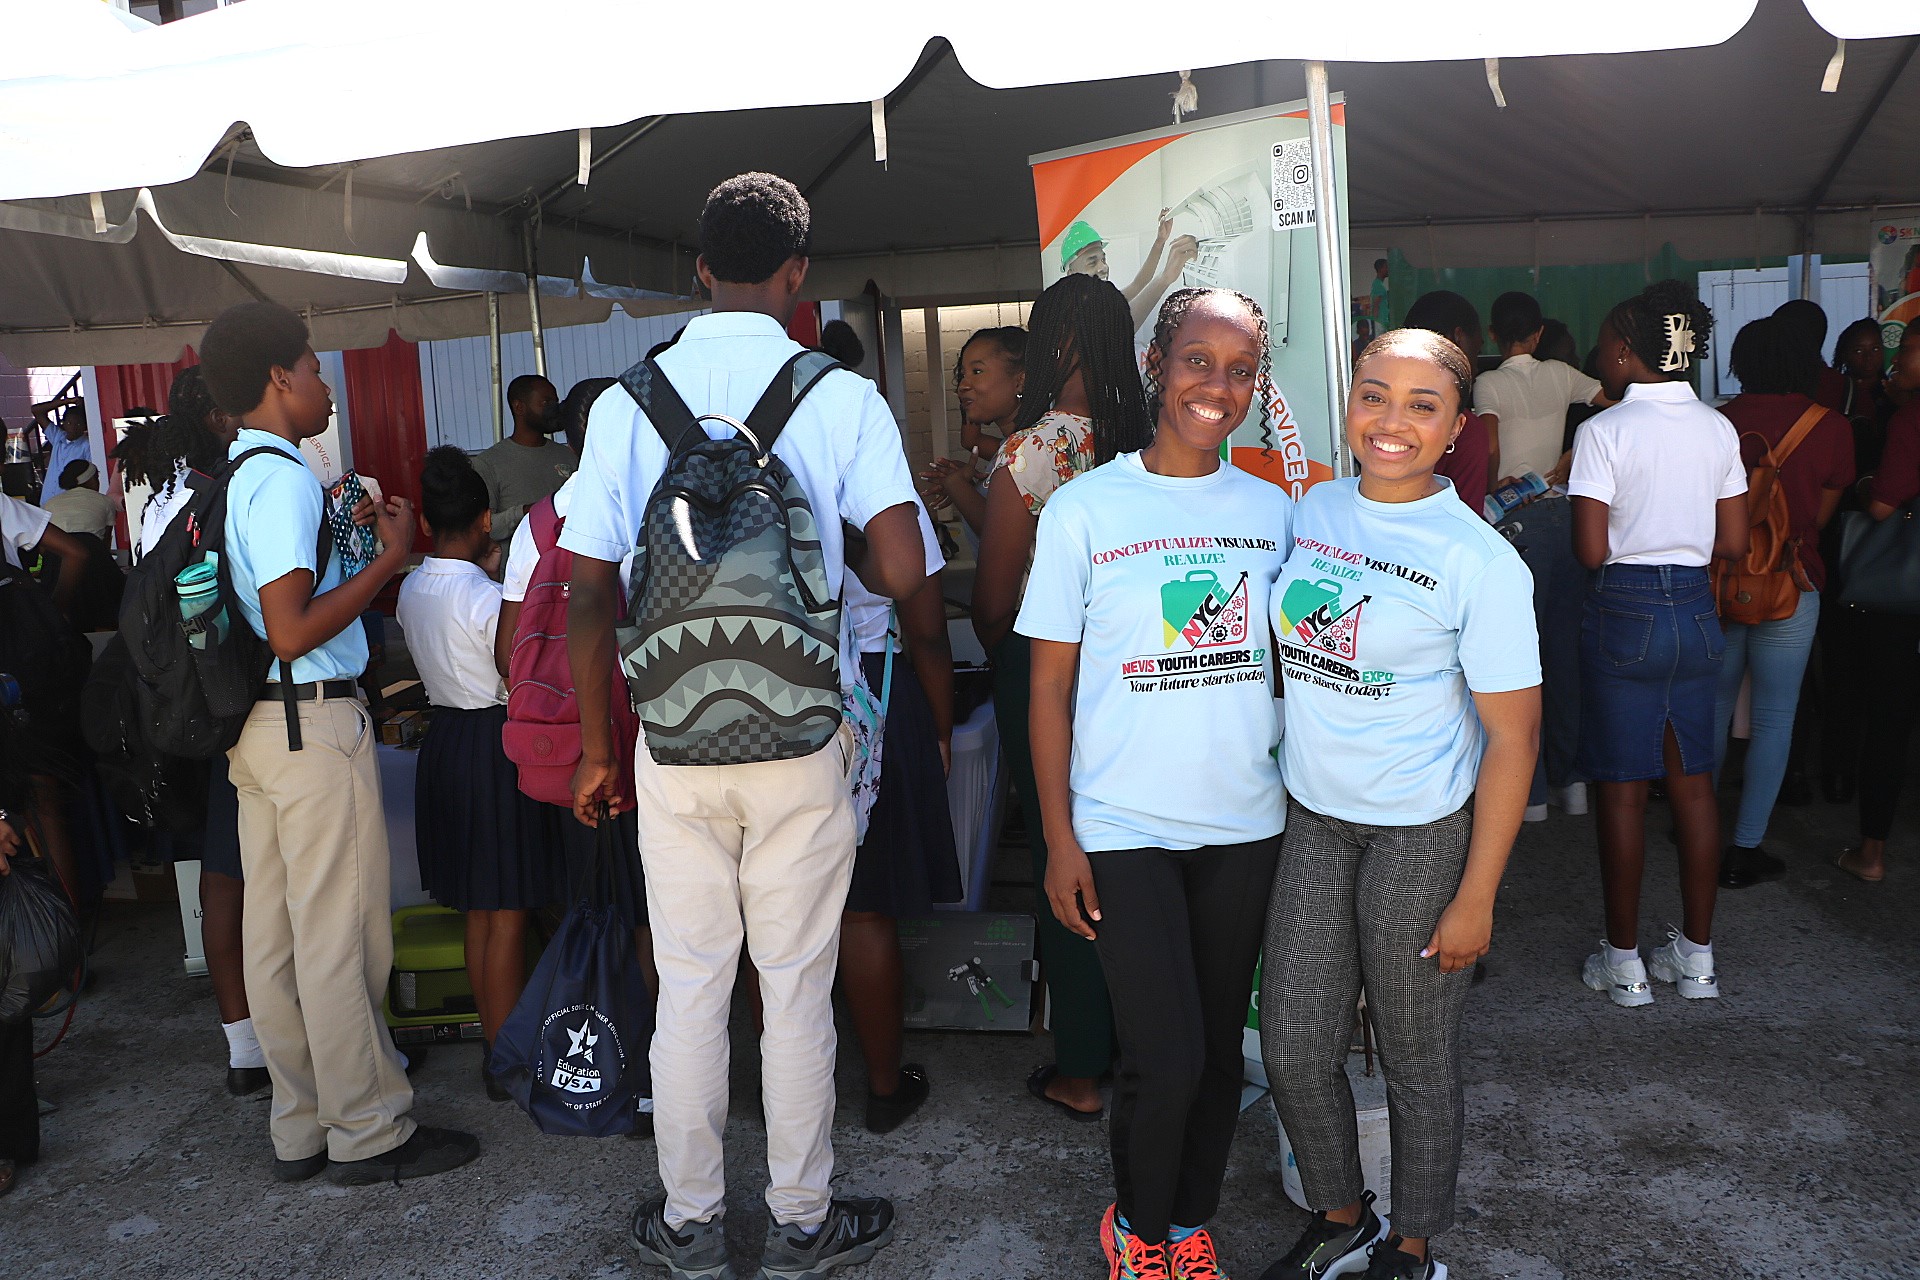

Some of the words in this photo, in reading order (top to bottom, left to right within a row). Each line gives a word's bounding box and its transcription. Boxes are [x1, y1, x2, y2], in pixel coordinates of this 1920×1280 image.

[1278, 210, 1303, 227] SCAN
[1092, 536, 1213, 565] CONCEPTUALIZE!
[1163, 552, 1226, 567] REALIZE!
[1310, 557, 1363, 582] REALIZE!
[1364, 556, 1438, 591] VISUALIZE!
[1181, 581, 1231, 647] NYCE
[1295, 596, 1343, 644] NYCE
[1121, 659, 1155, 675] NEVIS
[1157, 656, 1198, 672] YOUTH
[1199, 649, 1251, 668] CAREERS
[1280, 642, 1311, 667] YOUTH
[1310, 653, 1360, 682] CAREERS
[1362, 670, 1394, 683] EXPO
[1129, 679, 1157, 693] Your
[1158, 676, 1200, 692] future
[1201, 671, 1235, 687] starts
[1312, 675, 1343, 693] starts
[1344, 681, 1391, 701] today!
[544, 1006, 571, 1026] OFFICIAL
[607, 1022, 625, 1059] EDUCATION
[557, 1073, 594, 1090] USA
[585, 1098, 603, 1110] STATE
[836, 1214, 860, 1240] N
